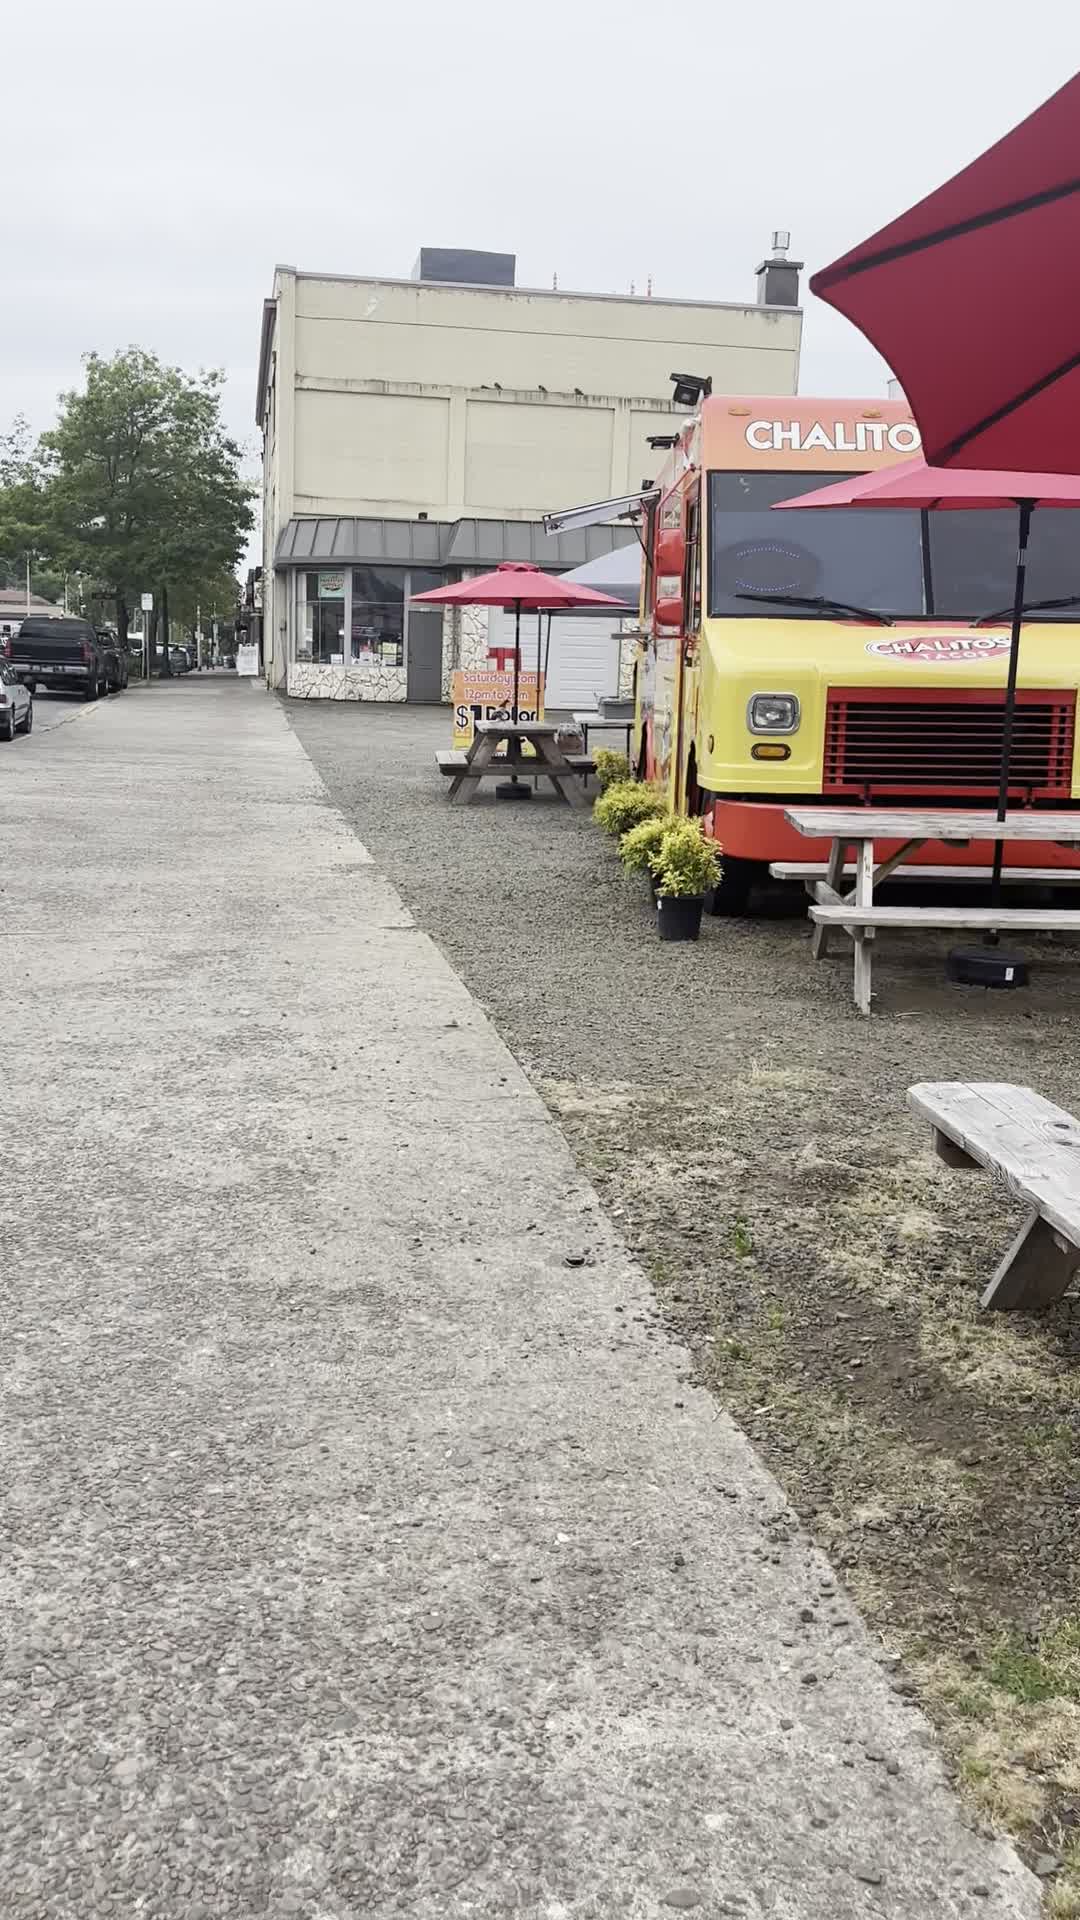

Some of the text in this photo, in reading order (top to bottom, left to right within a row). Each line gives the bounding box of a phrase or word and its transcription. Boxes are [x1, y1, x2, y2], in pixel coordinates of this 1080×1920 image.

[745, 420, 922, 452] CHALITO
[871, 638, 1011, 654] CHALITOS
[463, 672, 510, 685] Saturday
